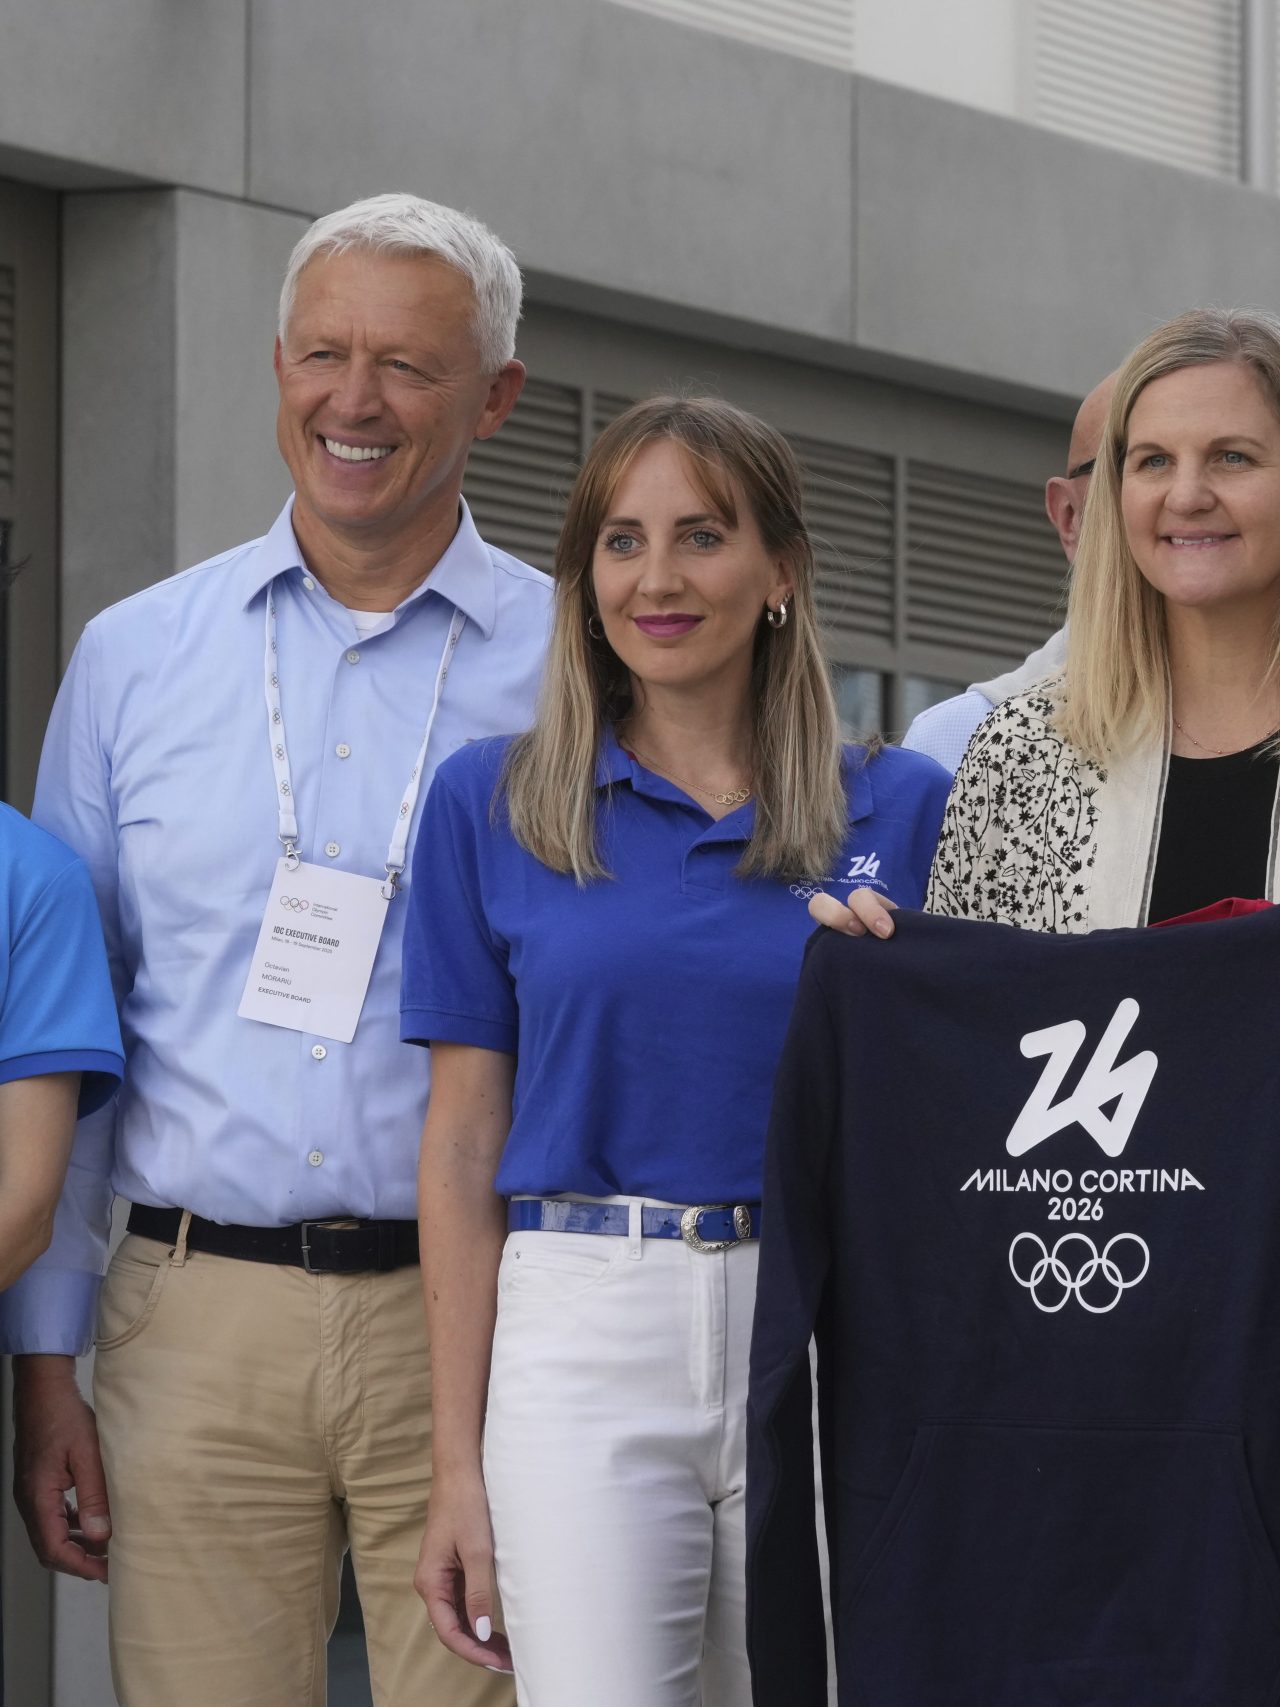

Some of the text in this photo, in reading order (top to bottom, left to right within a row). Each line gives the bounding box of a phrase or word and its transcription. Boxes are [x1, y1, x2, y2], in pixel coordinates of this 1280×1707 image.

[273, 925, 340, 948] IOC EXECUTIVE BOARD
[264, 961, 290, 972] Octavian
[261, 973, 292, 986] MORARIU
[257, 986, 312, 1004] EXECUTIVE BOARD
[960, 1168, 1206, 1193] MILANO CORTINA
[1047, 1197, 1104, 1221] 2026
